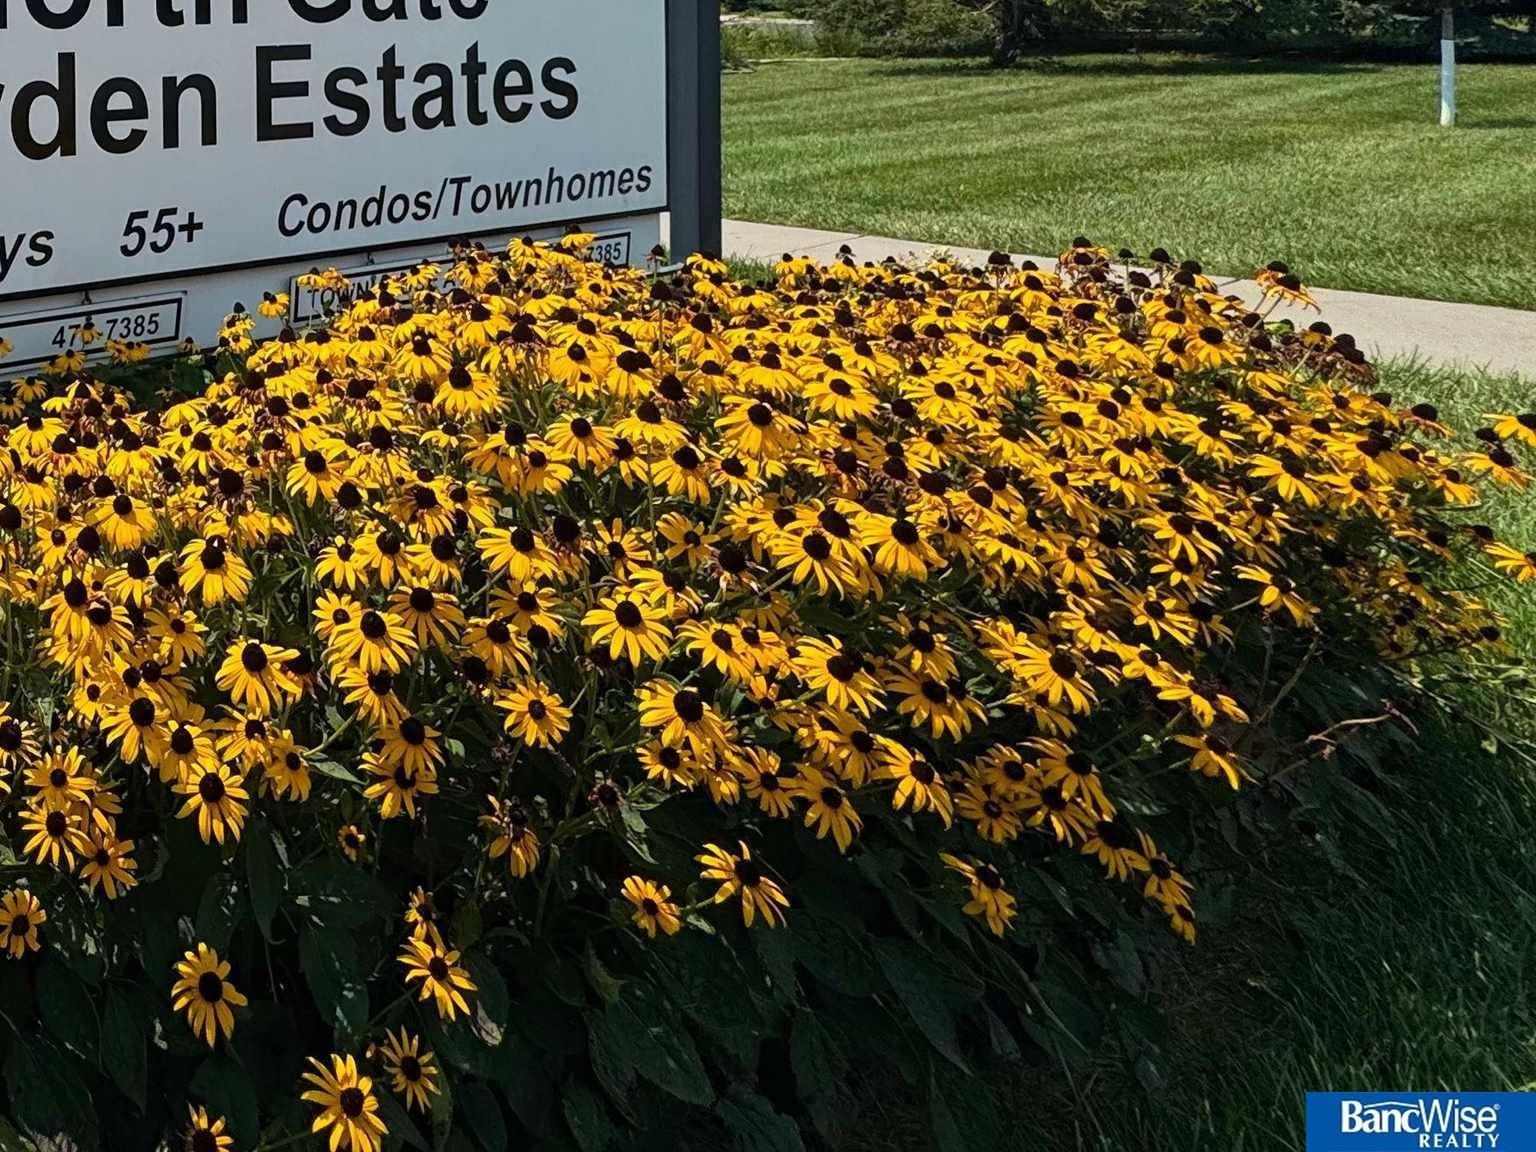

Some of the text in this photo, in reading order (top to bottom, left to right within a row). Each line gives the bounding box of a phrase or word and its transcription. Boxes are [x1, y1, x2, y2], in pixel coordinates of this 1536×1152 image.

[255, 40, 579, 143] Estates
[119, 206, 204, 258] 55+
[276, 164, 652, 238] Condos/Townhomes
